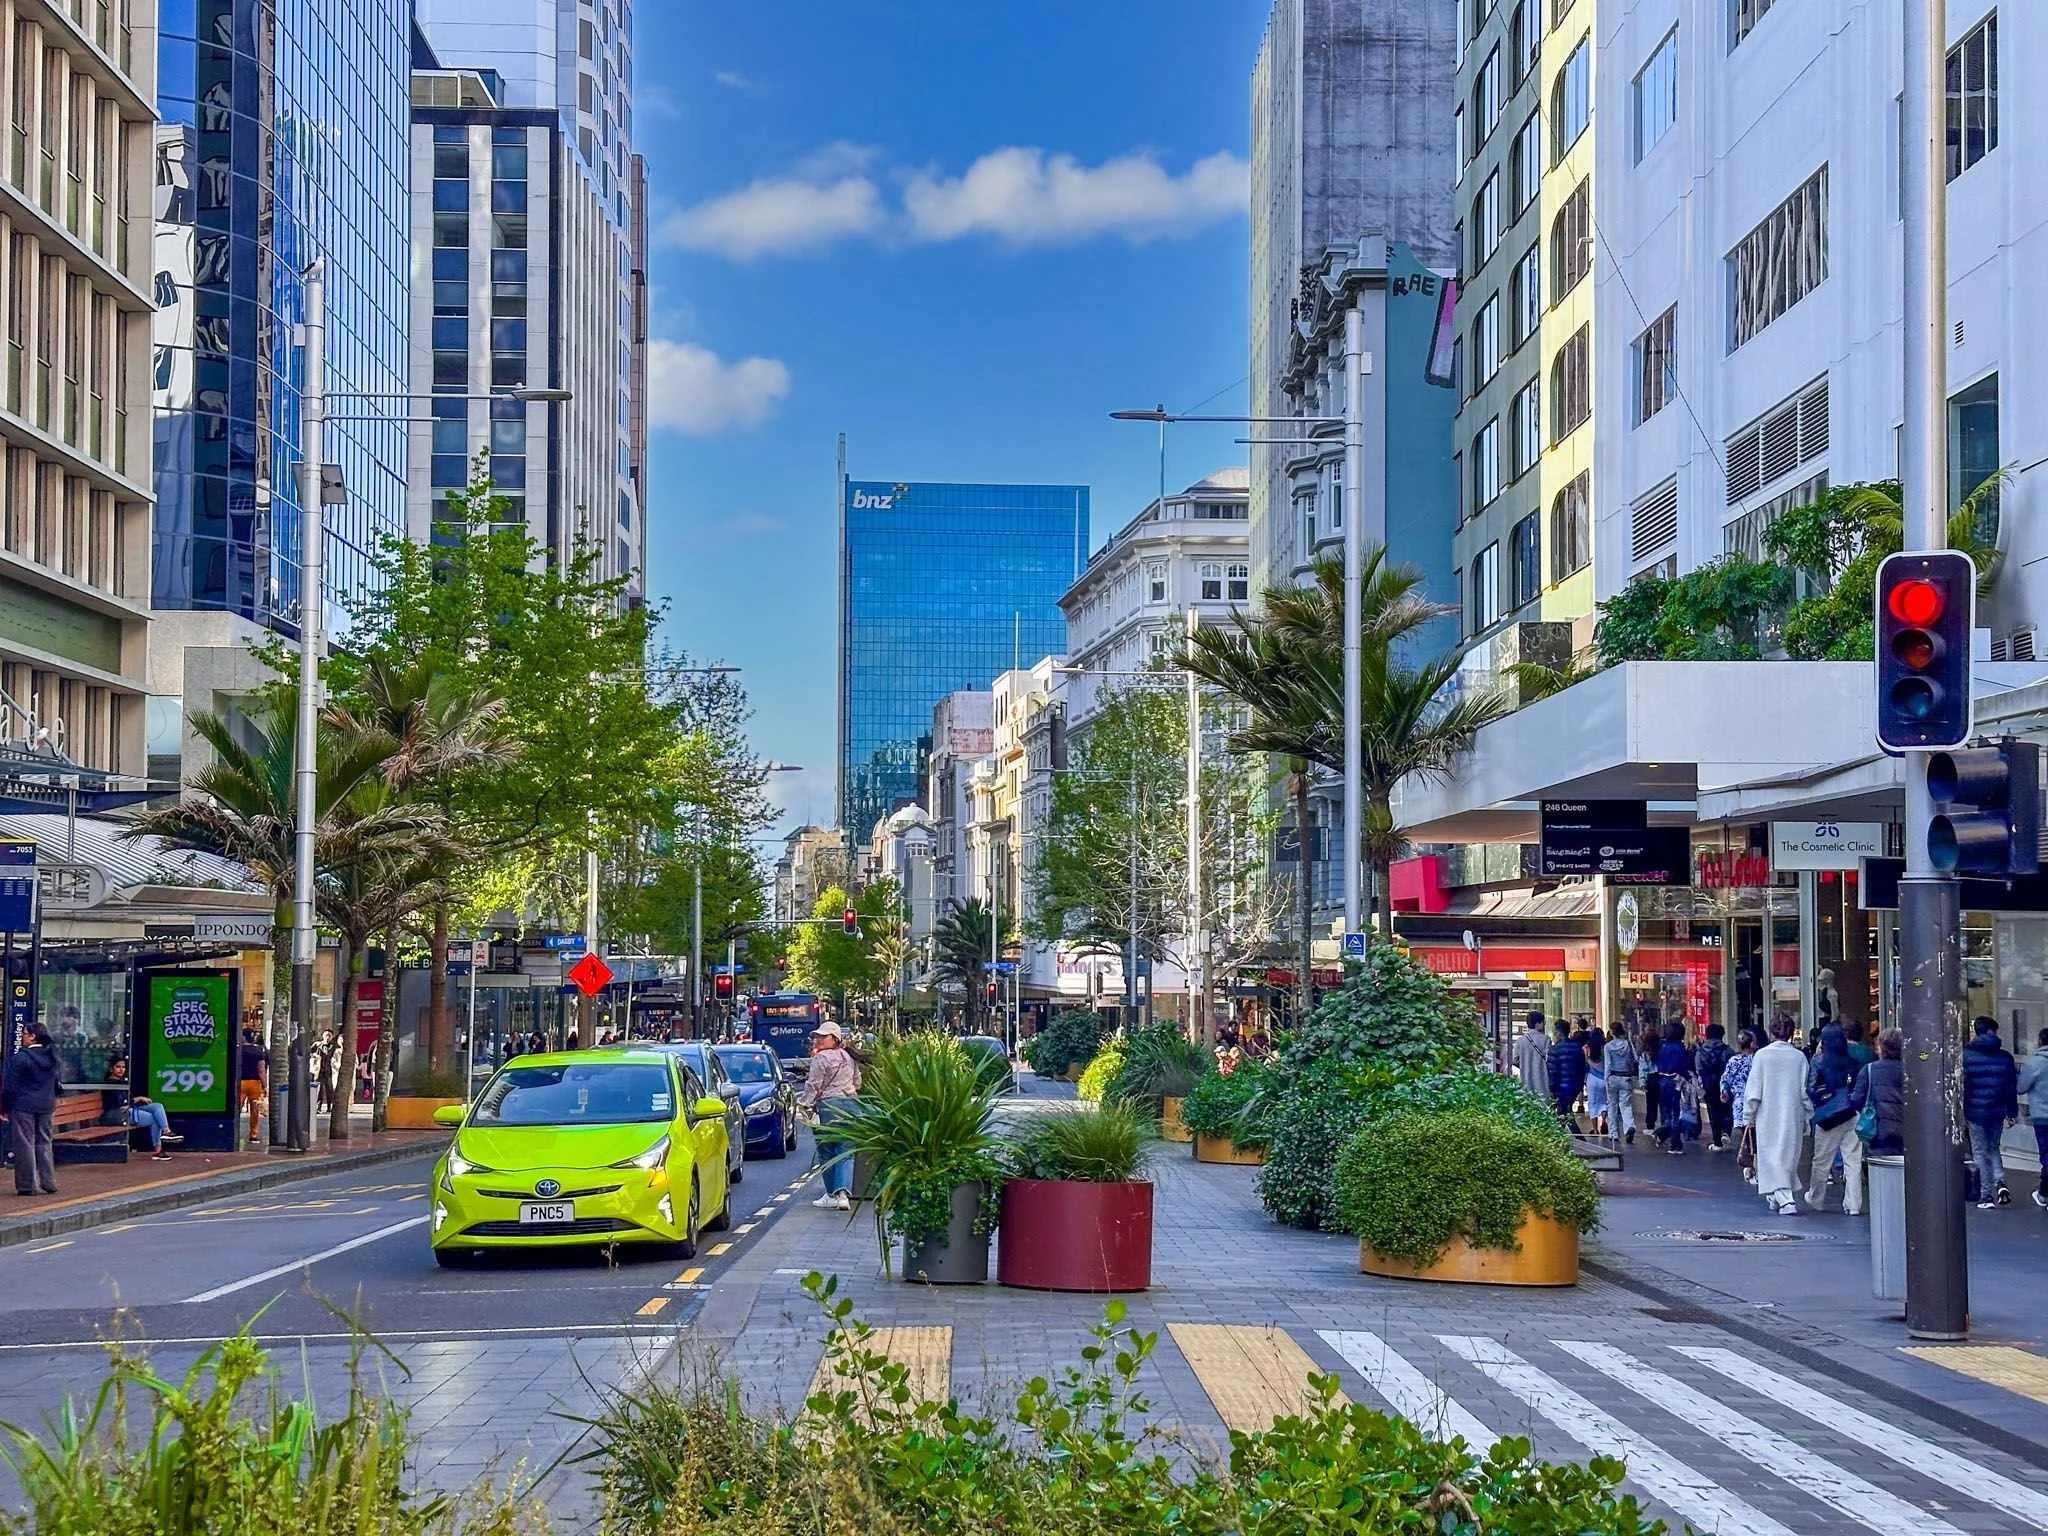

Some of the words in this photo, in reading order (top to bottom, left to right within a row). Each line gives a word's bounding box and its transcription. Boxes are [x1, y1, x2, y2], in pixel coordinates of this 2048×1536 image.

[1393, 273, 1436, 297] RAE
[852, 489, 893, 509] bnz
[1561, 803, 1588, 812] Queen
[16, 846, 33, 854] 7053
[1782, 841, 1799, 852] The
[1801, 841, 1845, 852] Cosmetic
[1847, 841, 1875, 852] Clinic
[198, 924, 267, 936] IPPONDO
[399, 959, 419, 969] THE
[173, 1001, 209, 1014] SPEC
[15, 1013, 24, 1022] St
[163, 1013, 215, 1027] STRAVA
[164, 1024, 215, 1039] GANZA
[779, 1027, 803, 1035] Metro
[156, 1070, 214, 1093] $299
[530, 1206, 564, 1220] PNC5
